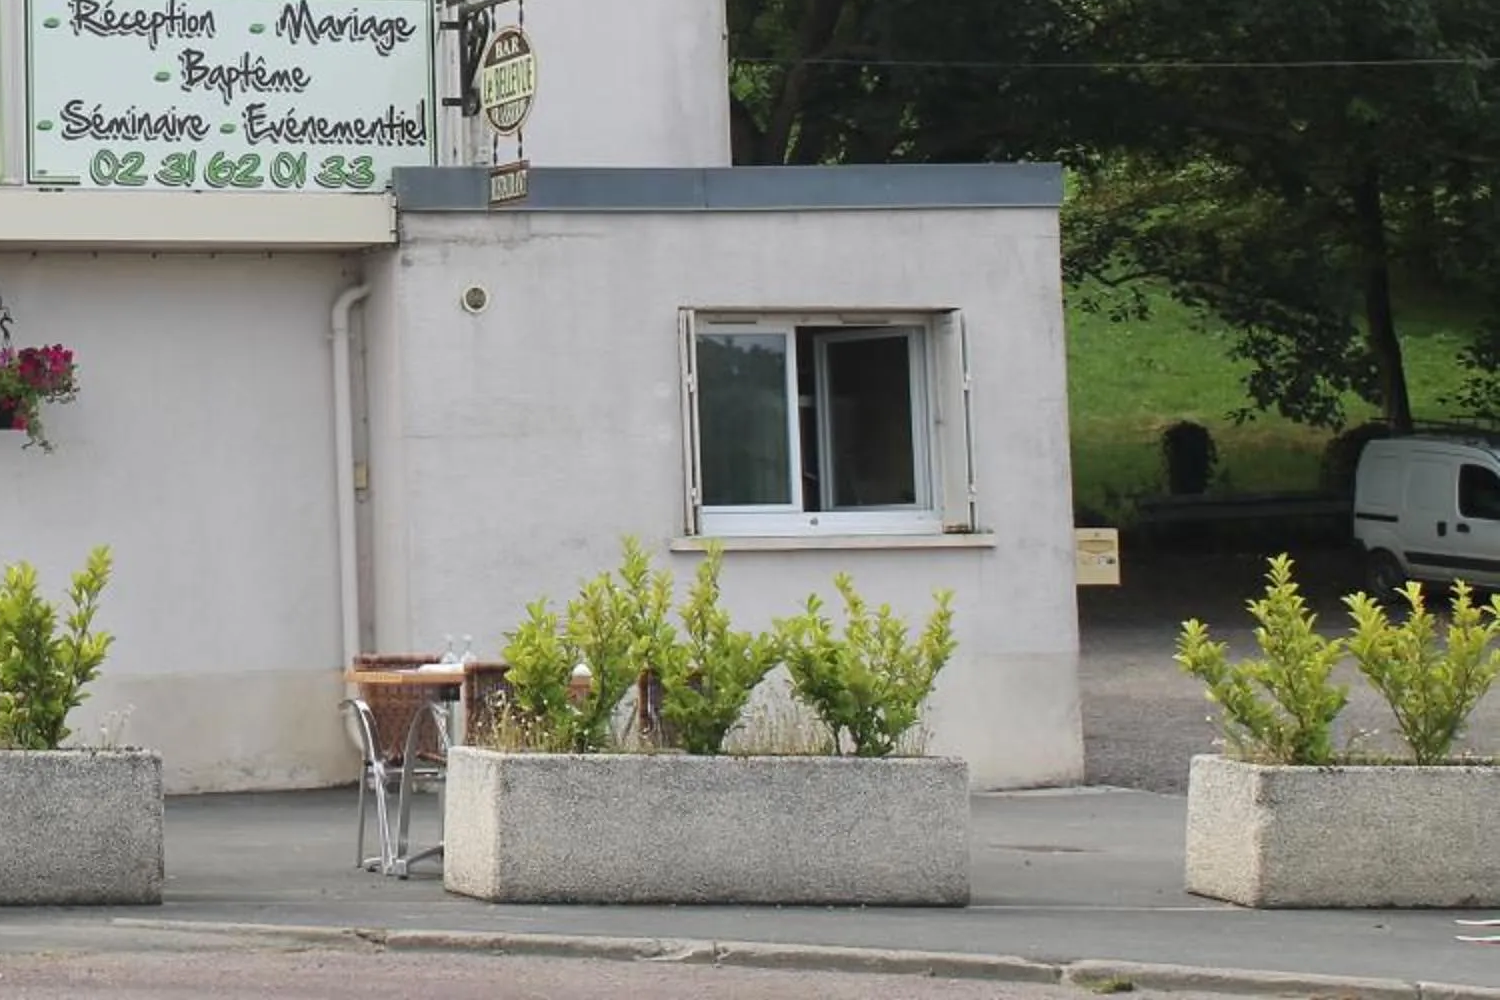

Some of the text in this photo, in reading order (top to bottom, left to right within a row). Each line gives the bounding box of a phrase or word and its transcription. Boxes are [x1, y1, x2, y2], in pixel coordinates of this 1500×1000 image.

[276, 0, 417, 56] Mariage
[495, 35, 520, 60] BAR
[178, 48, 312, 105] Baptême
[60, 99, 428, 149] Séminaire Evénementiel
[89, 149, 377, 190] 02 31 62 01 33
